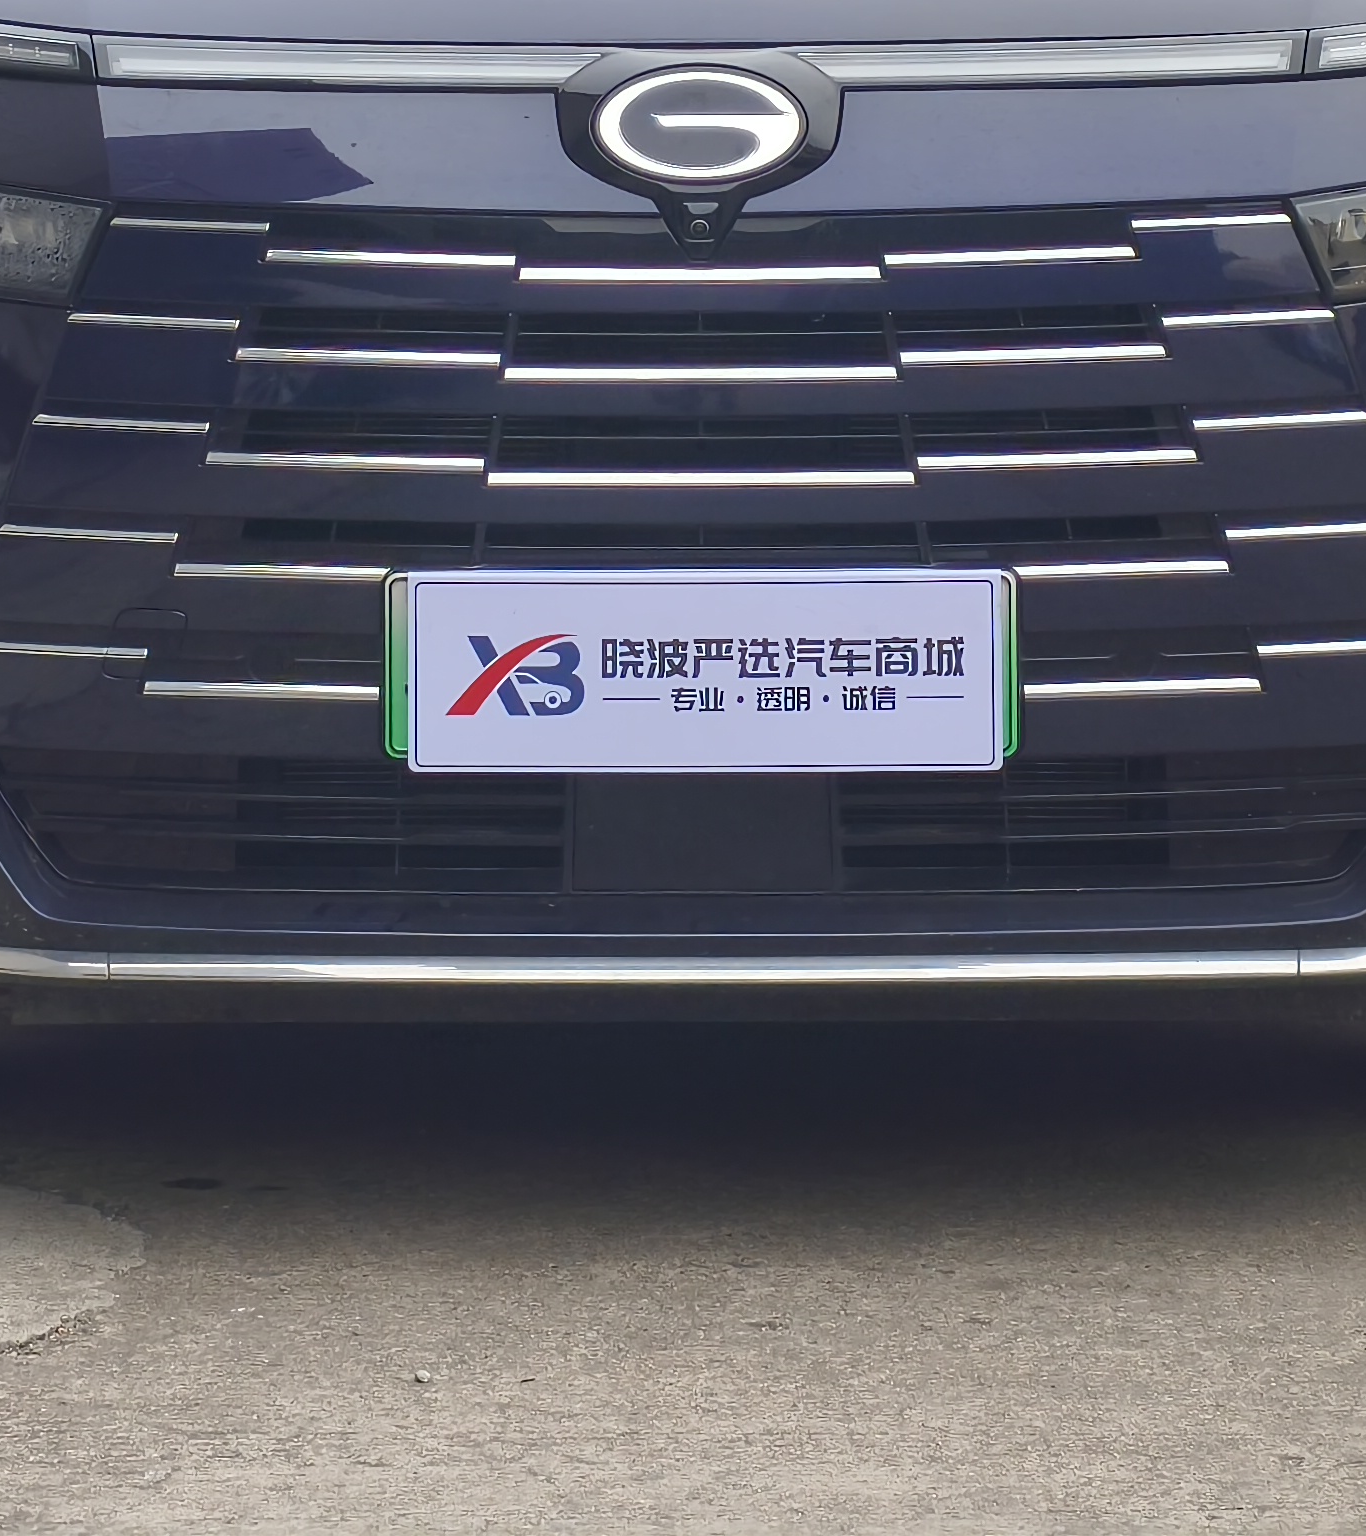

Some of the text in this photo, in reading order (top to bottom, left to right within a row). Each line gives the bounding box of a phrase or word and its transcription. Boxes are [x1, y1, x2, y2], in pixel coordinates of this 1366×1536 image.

[600, 636, 966, 679] 晓波严选汽车商城
